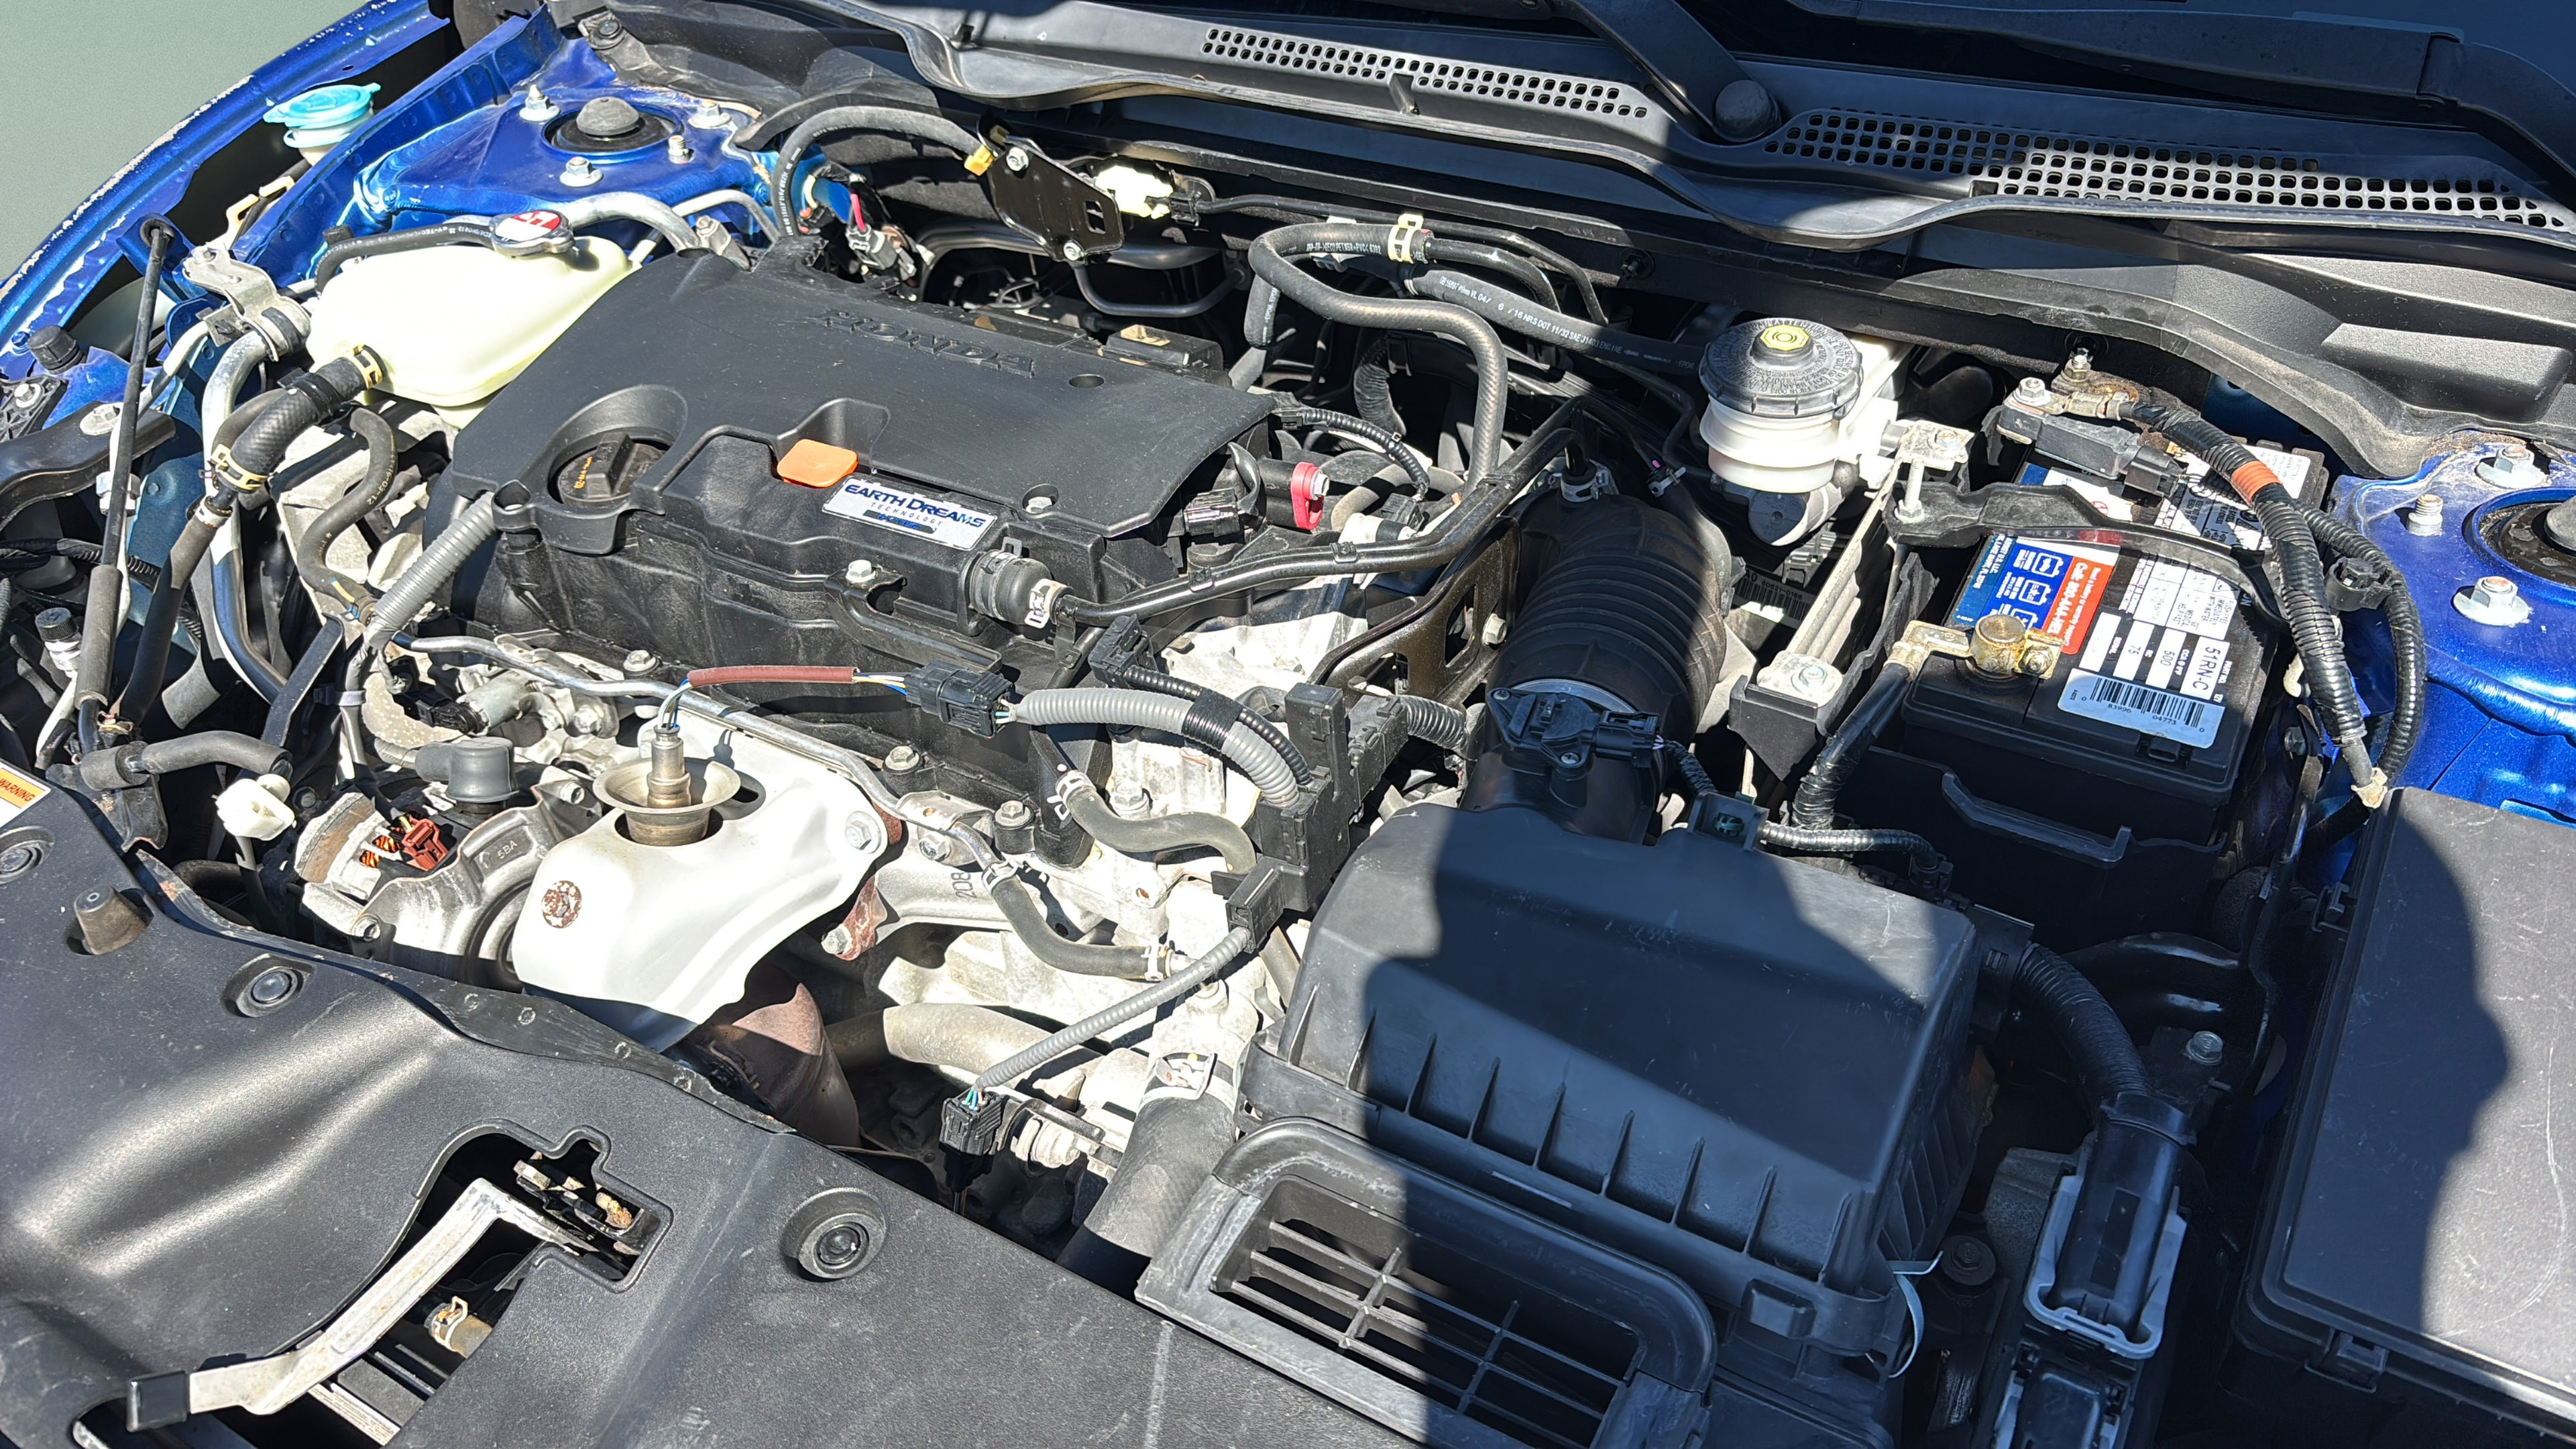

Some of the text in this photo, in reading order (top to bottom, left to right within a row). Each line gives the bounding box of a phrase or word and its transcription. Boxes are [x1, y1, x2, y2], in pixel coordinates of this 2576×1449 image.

[1497, 302, 1505, 311] 6
[1536, 319, 1551, 330] DOT
[811, 310, 1035, 377] HONDA
[844, 482, 986, 529] EARTH DREAMS
[871, 502, 943, 527] TECHNOLOGY
[1989, 541, 2002, 555] LAKE
[2088, 567, 2101, 580] Need
[2046, 561, 2088, 635] Call: 800-AAA-HEL
[2078, 583, 2094, 599] battery
[2068, 604, 2084, 625] warranty
[2127, 645, 2141, 655] 75
[2160, 650, 2175, 666] 500
[2191, 646, 2221, 690] 51RN-C
[2107, 702, 2131, 713] 83996
[2151, 714, 2176, 725] 04773
[0, 778, 36, 802] WARNING
[496, 838, 518, 859] 5BA
[951, 871, 976, 900] 208
